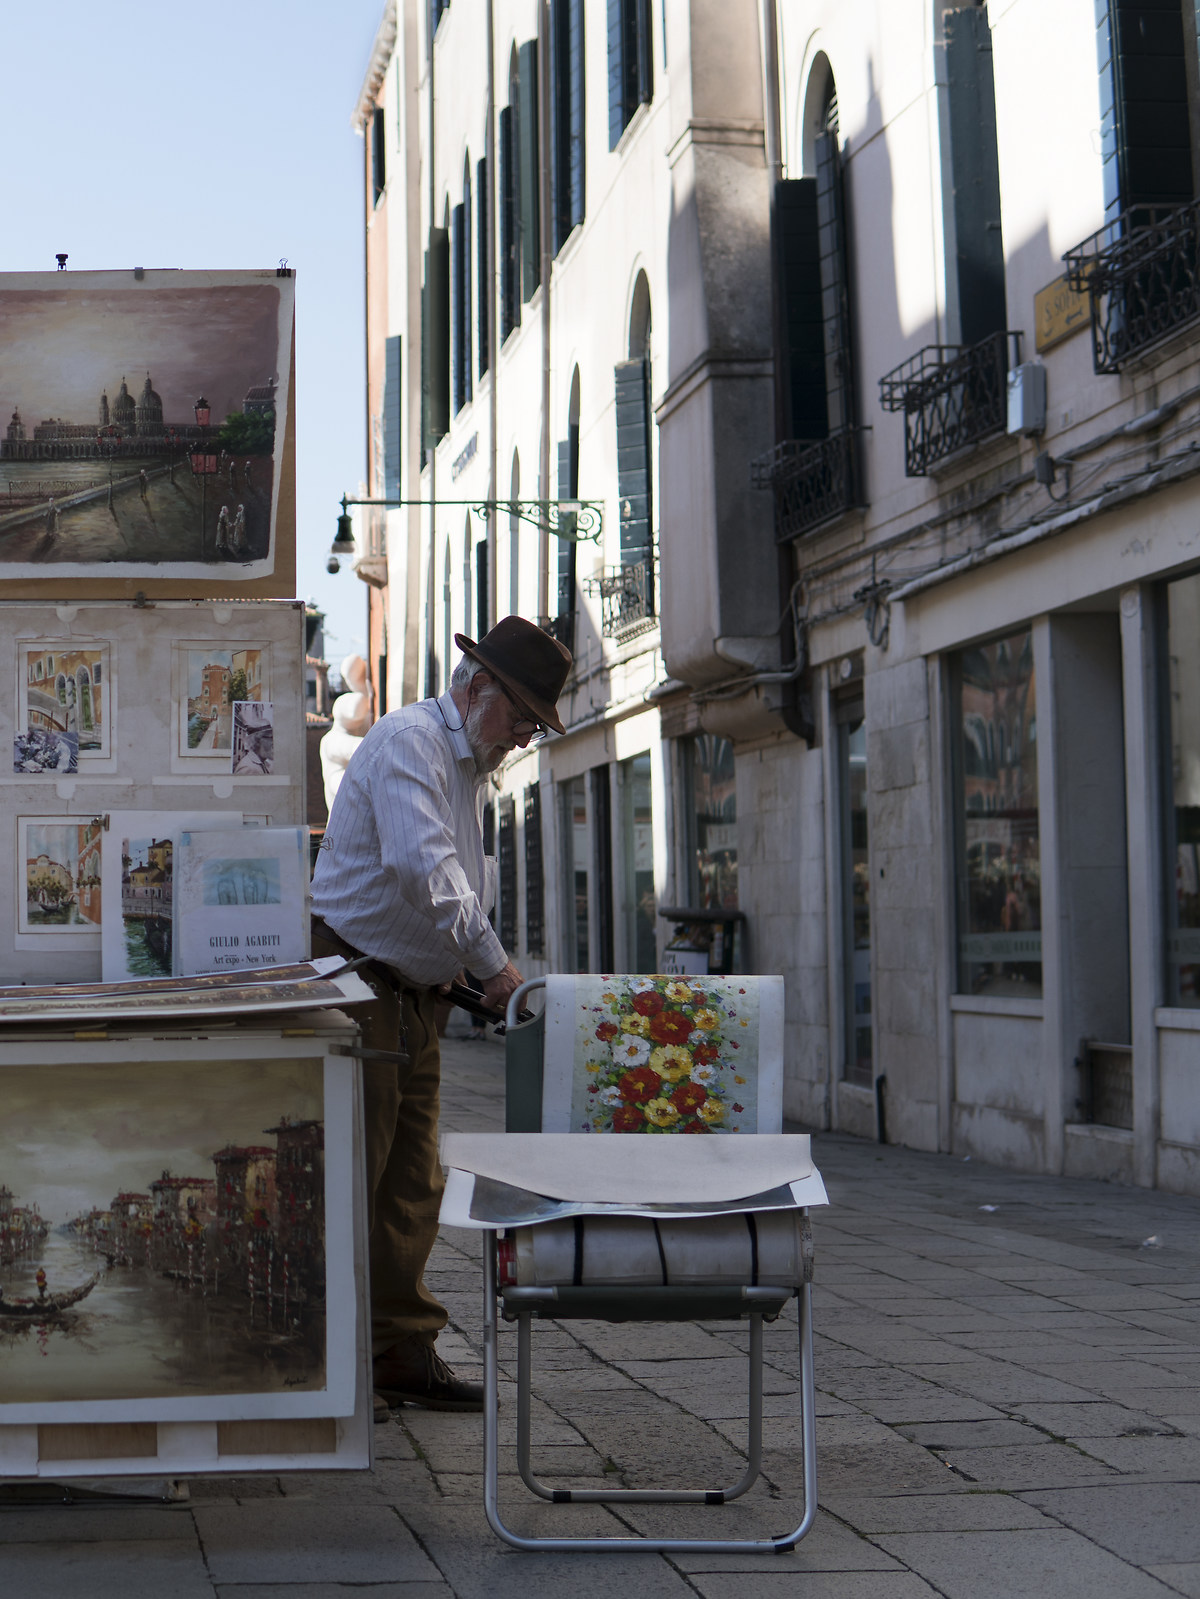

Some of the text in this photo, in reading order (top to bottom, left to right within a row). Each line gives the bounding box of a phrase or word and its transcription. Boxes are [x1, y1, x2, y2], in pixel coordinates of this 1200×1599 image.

[209, 935, 280, 947] GIULIO AGABITI
[213, 956, 224, 964] Art
[246, 955, 259, 963] New
[261, 954, 277, 963] York
